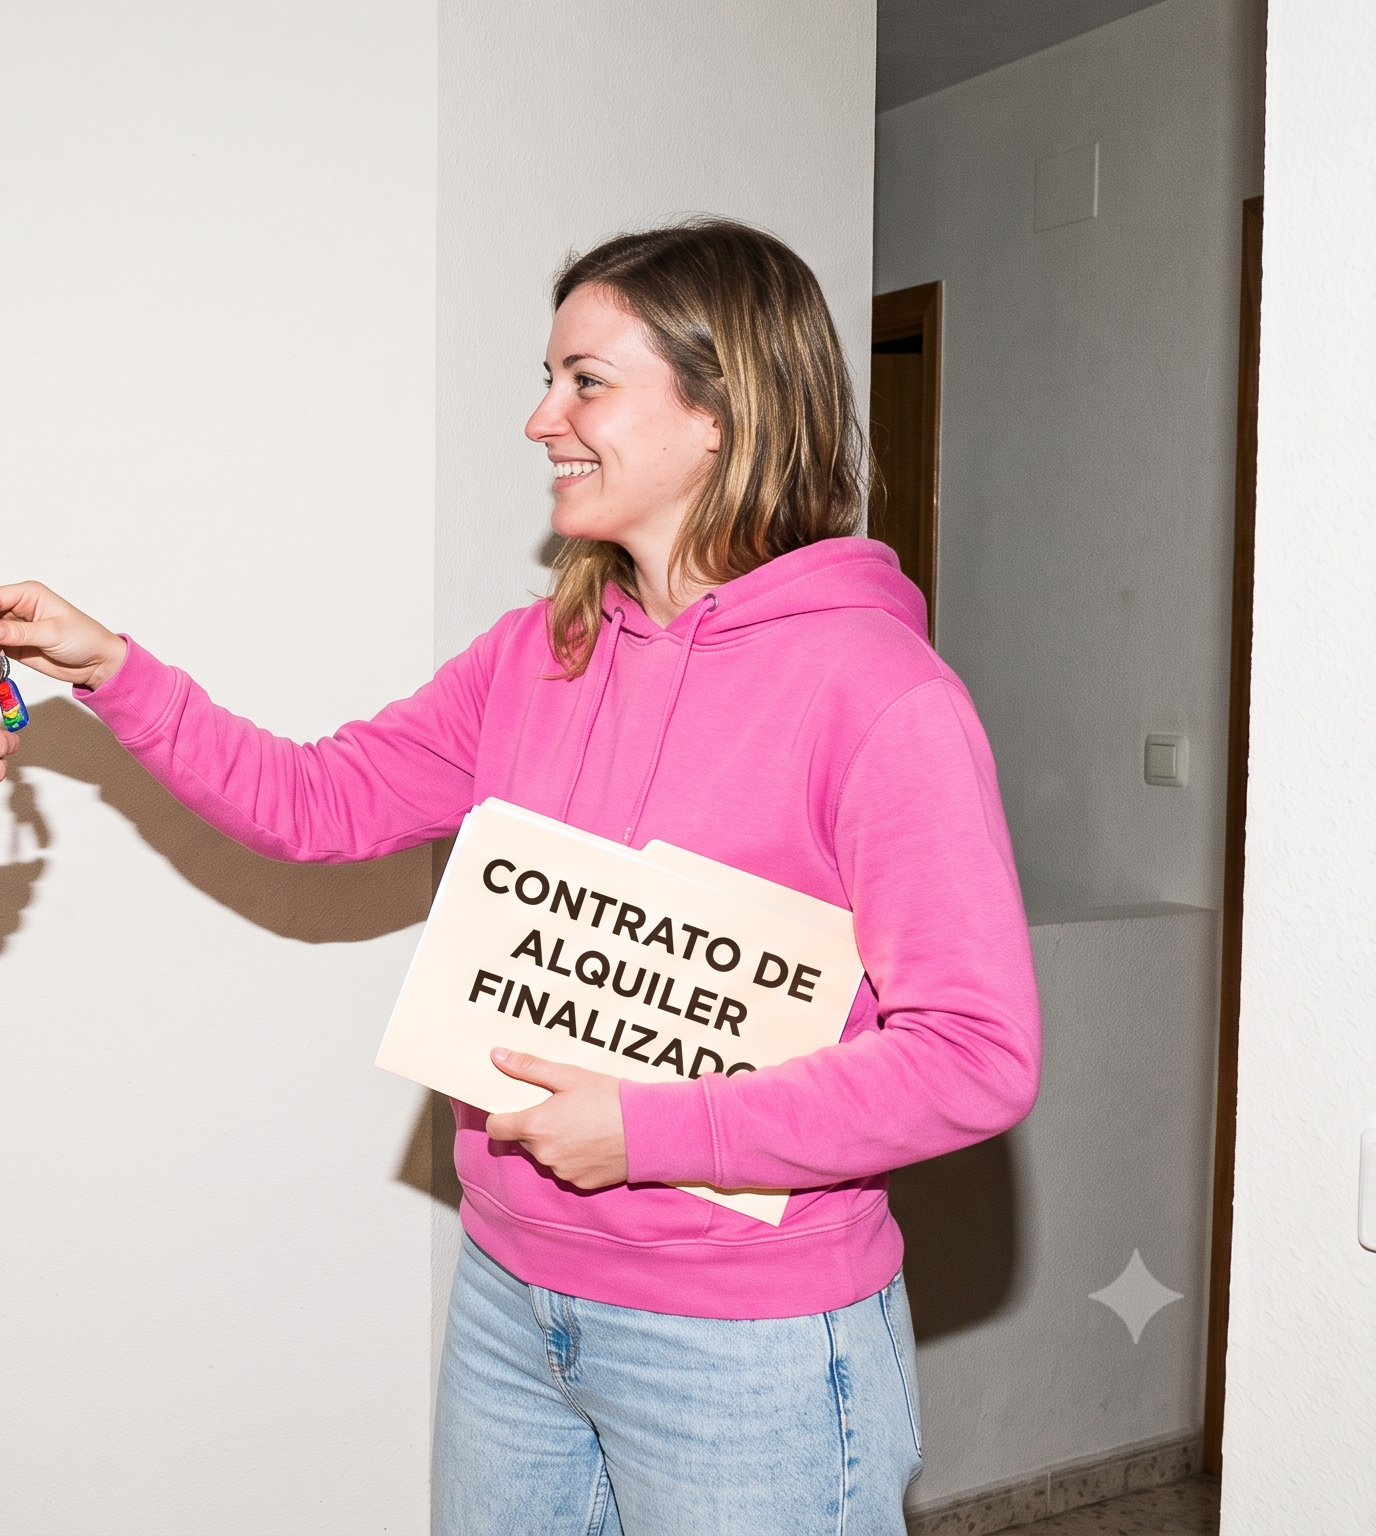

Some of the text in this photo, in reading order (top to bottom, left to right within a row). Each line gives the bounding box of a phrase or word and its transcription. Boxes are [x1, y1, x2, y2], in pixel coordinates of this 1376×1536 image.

[482, 858, 822, 1003] CONTRATO DE
[510, 928, 748, 1037] ALQUILER
